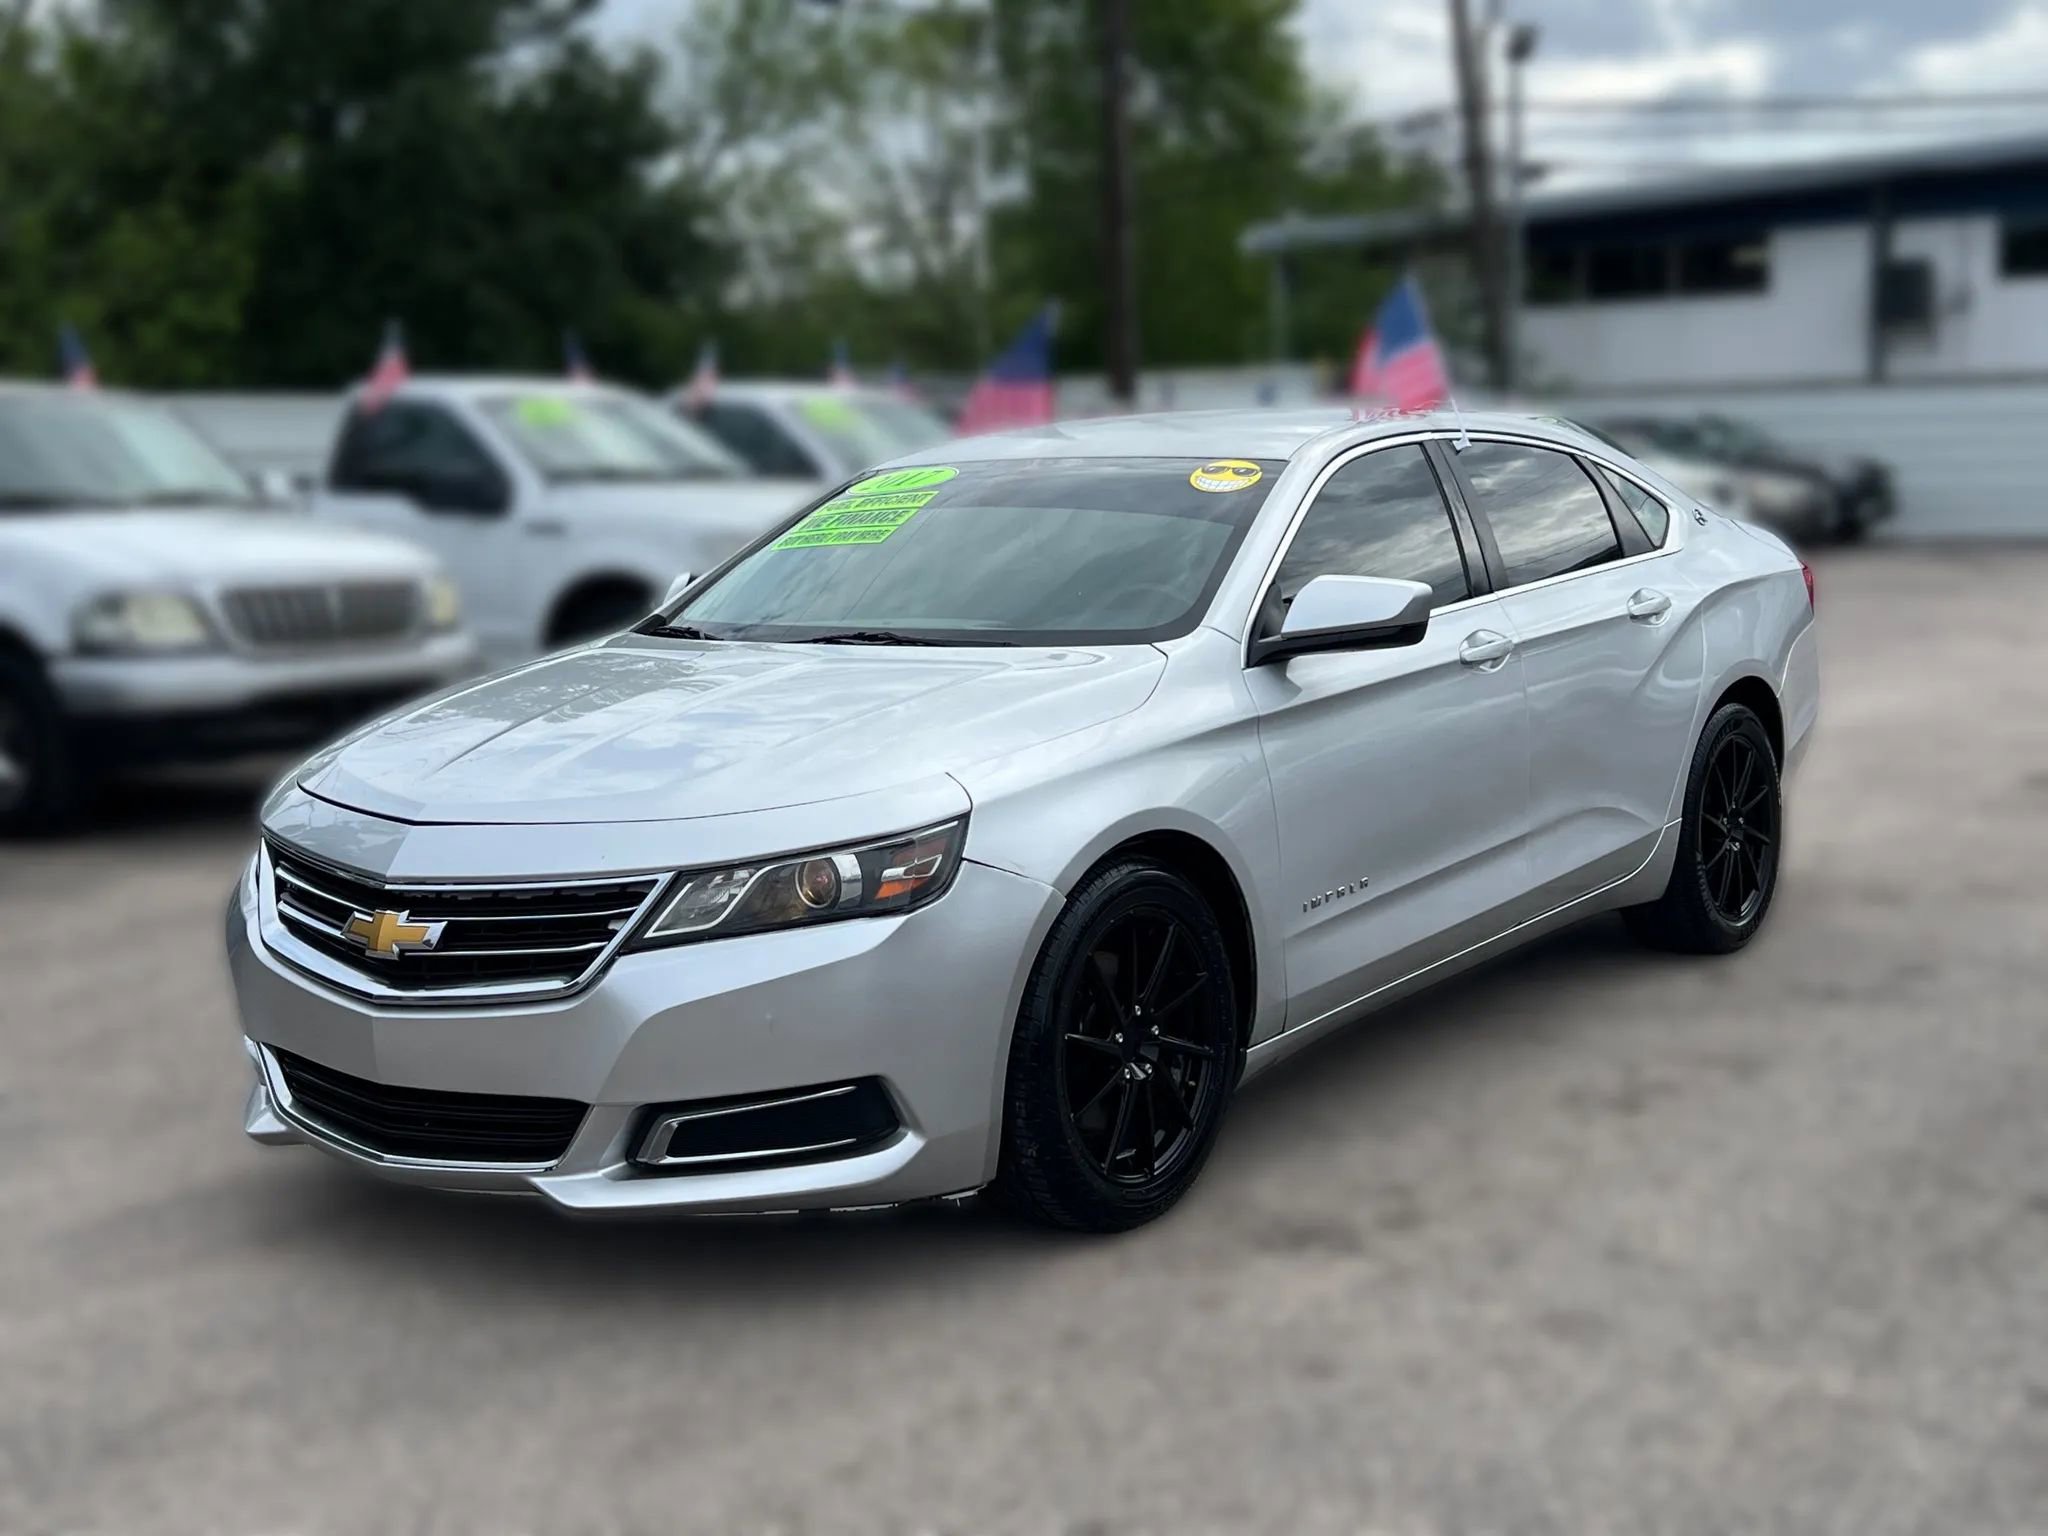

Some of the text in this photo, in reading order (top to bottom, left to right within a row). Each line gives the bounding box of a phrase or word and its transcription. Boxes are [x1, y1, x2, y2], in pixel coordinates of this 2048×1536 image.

[852, 492, 934, 509] EFFICIENT
[798, 509, 912, 530] WE FINANCE
[1302, 876, 1369, 912] IMPALA
